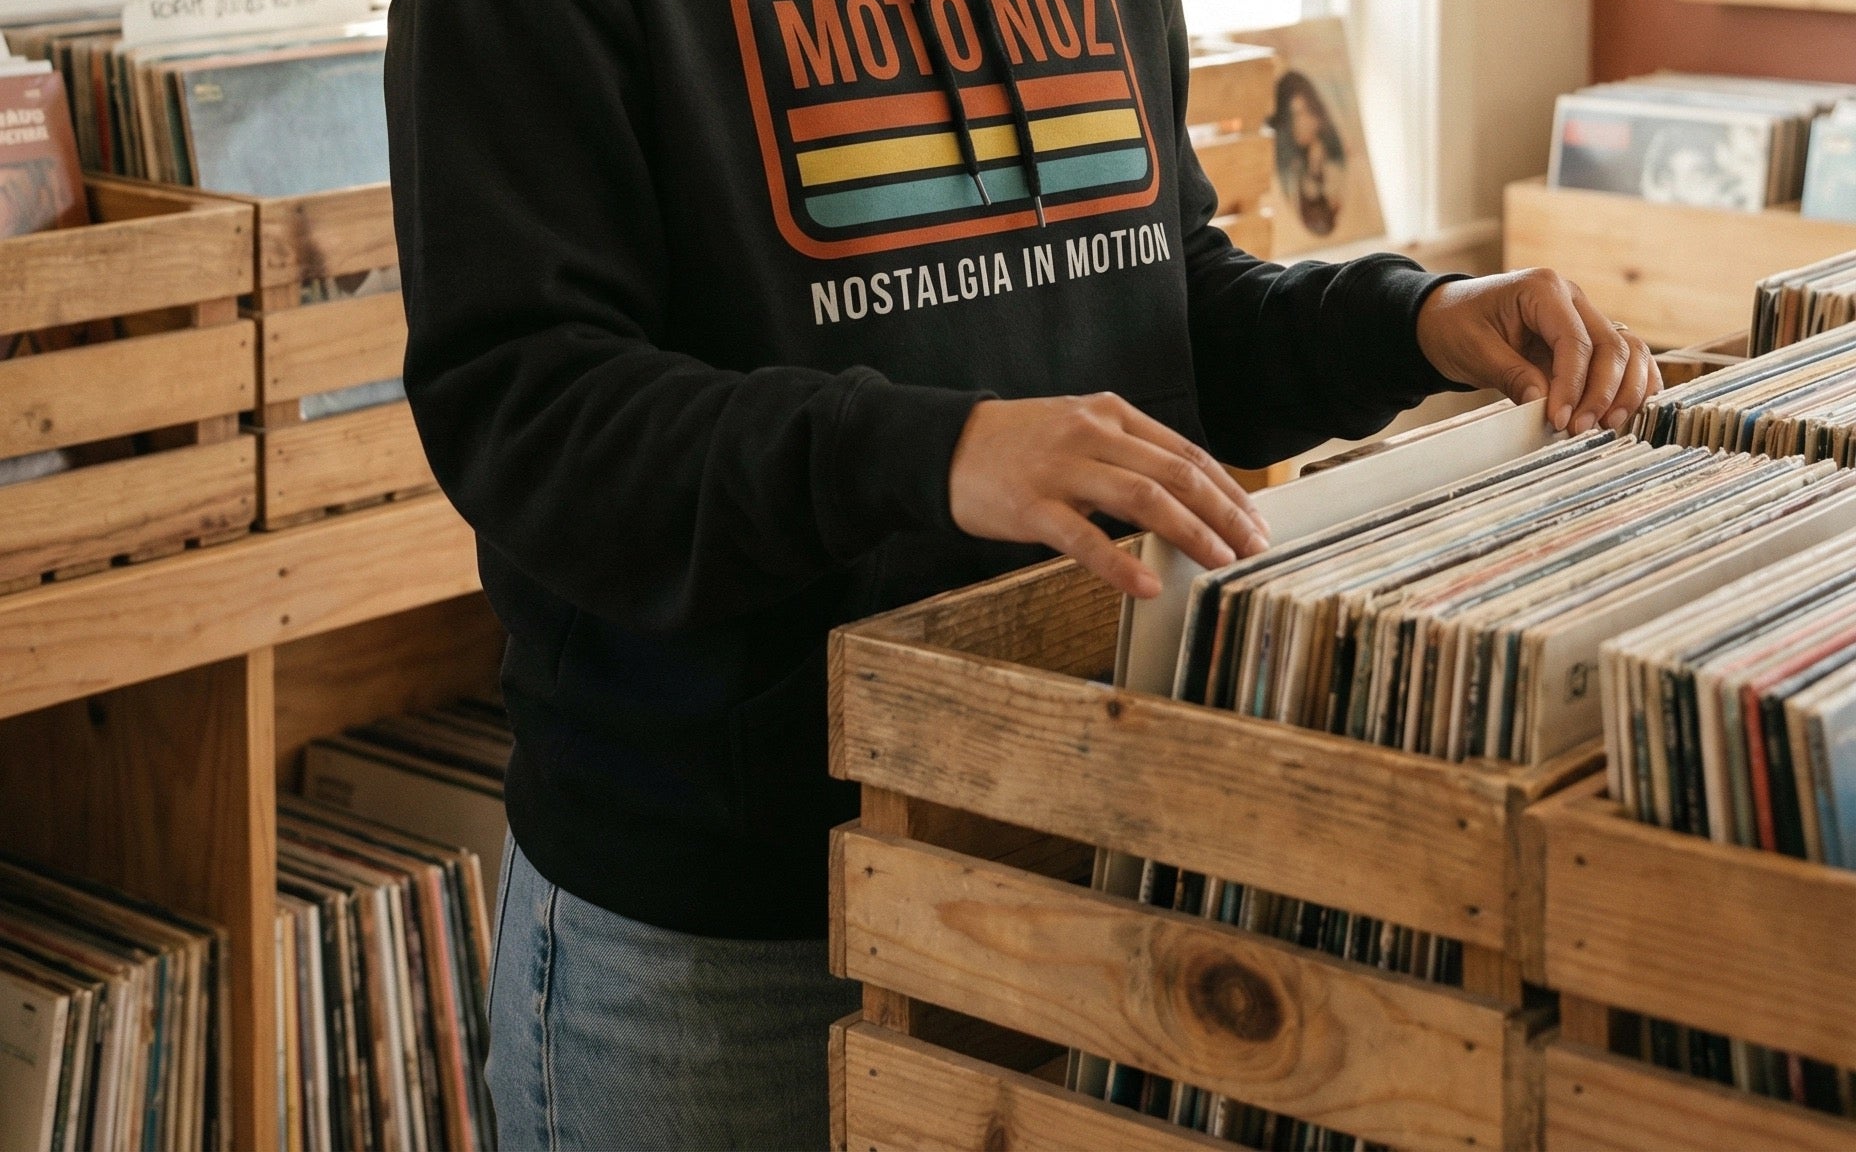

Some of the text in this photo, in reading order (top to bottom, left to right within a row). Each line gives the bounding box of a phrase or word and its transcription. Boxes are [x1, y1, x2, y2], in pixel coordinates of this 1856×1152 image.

[811, 222, 1171, 325] NOSTALGIA IN MOTION
